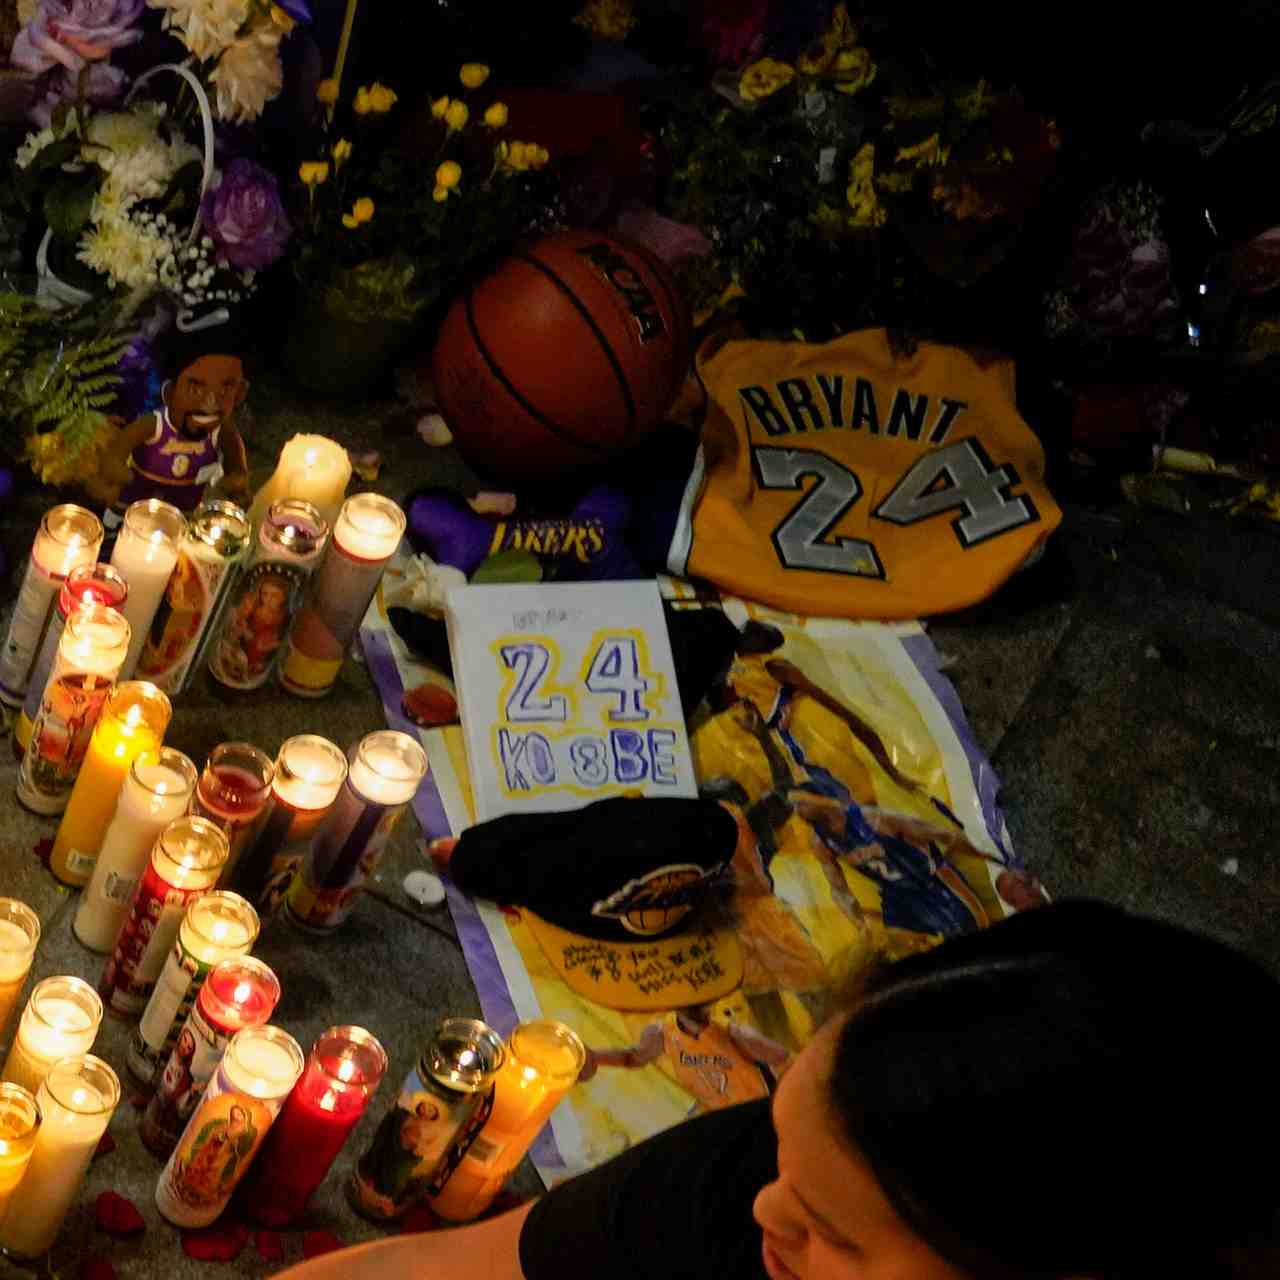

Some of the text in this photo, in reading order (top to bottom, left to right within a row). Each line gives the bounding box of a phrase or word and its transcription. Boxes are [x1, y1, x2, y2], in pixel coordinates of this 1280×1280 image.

[739, 373, 969, 446] BRYANT
[490, 520, 606, 564] LAKERS
[749, 434, 1041, 583] 24
[499, 637, 651, 722] 24
